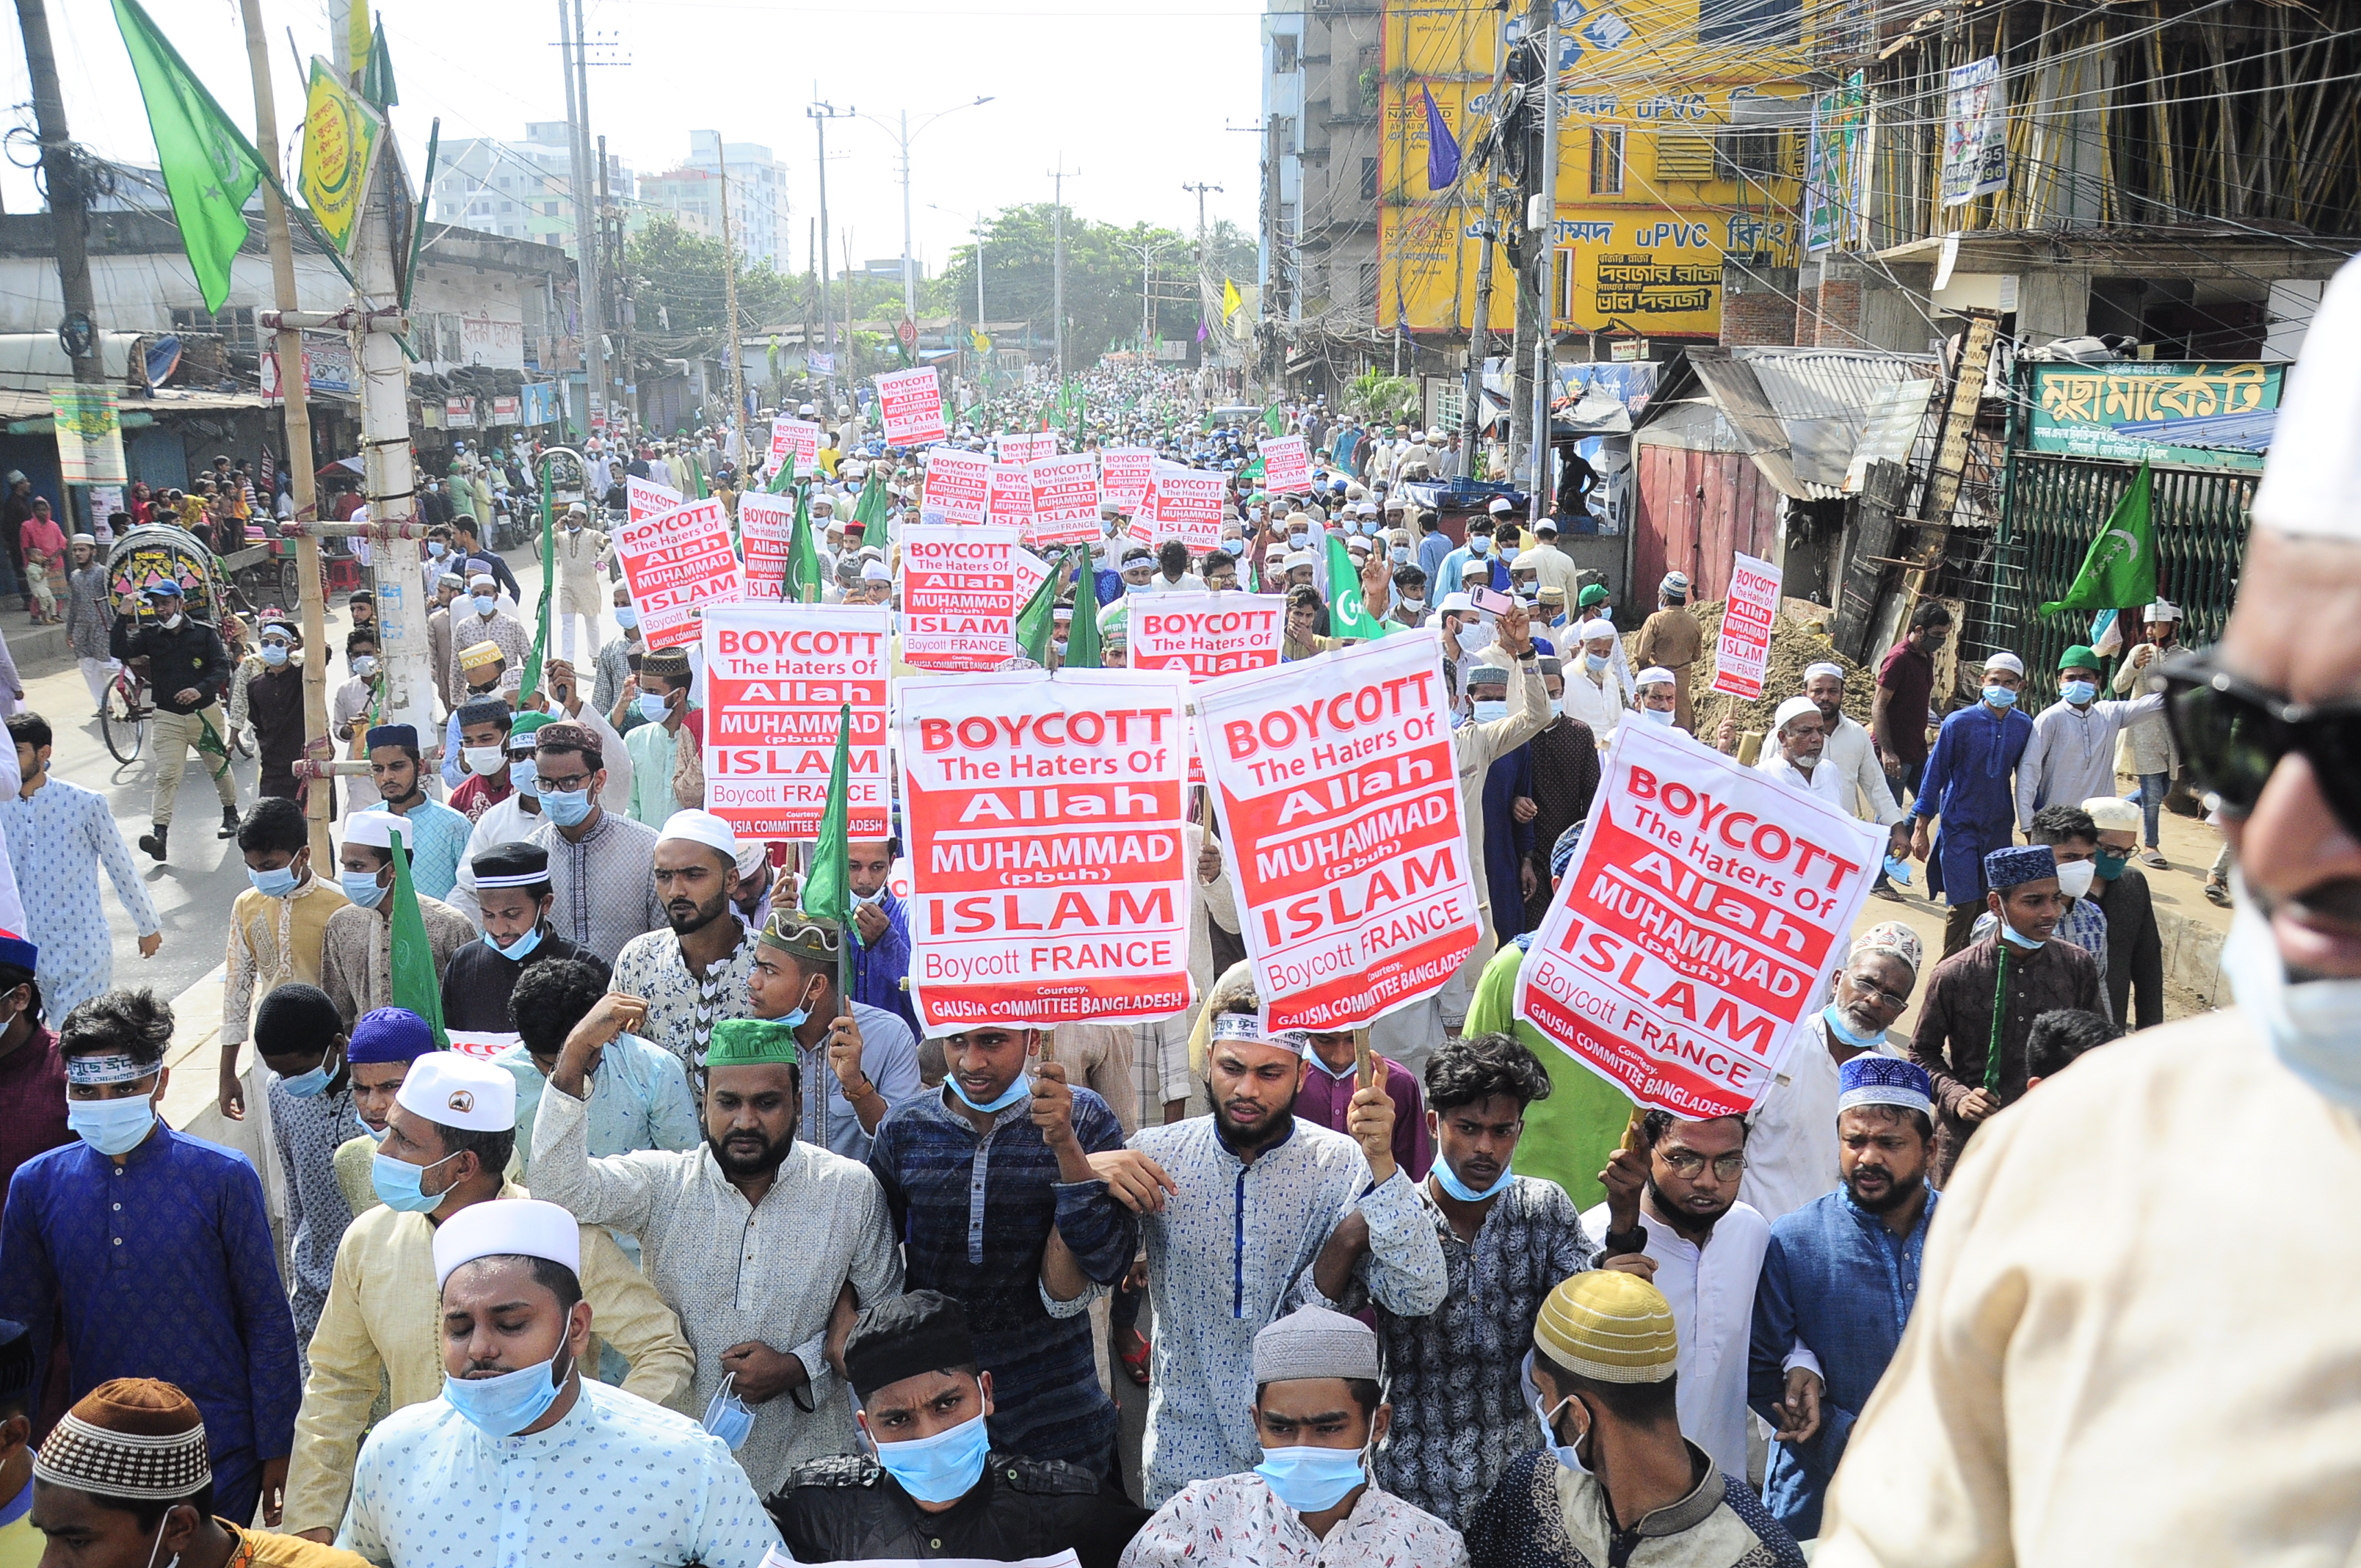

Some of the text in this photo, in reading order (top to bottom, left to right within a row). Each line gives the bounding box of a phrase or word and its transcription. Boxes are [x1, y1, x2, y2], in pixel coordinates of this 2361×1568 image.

[1636, 222, 1709, 248] uPVC
[1599, 265, 1722, 283] দরজার রাজা
[1597, 290, 1705, 310] ভাল দরজা
[882, 374, 934, 391] BOYCOTT
[2041, 363, 2266, 422] মুছা মার্কেট
[892, 391, 934, 404] Allah
[887, 401, 937, 415] MUHAMMAD
[888, 412, 940, 427] ISLAM
[910, 422, 940, 433] FRANCE
[1003, 440, 1052, 452] BOYCOTT
[932, 458, 988, 472] BOYCOTT
[950, 468, 974, 477] Haters
[1034, 463, 1092, 478] BOYCOTT
[929, 484, 983, 498] MUHAMMAD
[937, 476, 982, 487] Allah
[1043, 483, 1090, 496] Allah
[1163, 479, 1222, 490] BOYCOTT
[637, 500, 648, 508] The
[926, 496, 981, 511] ISLAM
[1037, 495, 1095, 509] MUHAMMAD
[1169, 498, 1216, 508] Allah
[623, 504, 717, 545] BOYCOTT
[744, 507, 790, 527] BOYCOTT
[1037, 508, 1095, 523] ISLAM
[1161, 509, 1219, 520] MUHAMMAD
[748, 525, 789, 538] The Haters Of
[1061, 520, 1095, 530] FRANCE
[1159, 523, 1217, 534] ISLAM
[632, 520, 719, 553] The Haters Of
[1182, 535, 1215, 545] FRANCE
[645, 537, 719, 567] Allah
[910, 542, 1012, 559] BOYCOTT
[637, 553, 730, 589] MUHAMMAD
[918, 559, 1009, 571] The Haters Of
[924, 574, 1004, 589] Allah
[1737, 569, 1777, 597] BOYCOTT
[641, 574, 737, 613] ISLAM
[913, 595, 1010, 609] MUHAMMAD
[1736, 587, 1773, 606] The Of
[646, 611, 683, 630] Boycott
[1734, 601, 1768, 623] Allah
[910, 617, 1009, 634] ISLAM
[1144, 610, 1277, 636] BOYCOTT
[719, 630, 882, 656] BOYCOTT
[908, 639, 1007, 652] Boycott FRANCE
[1152, 633, 1272, 651] The Haters Of
[1722, 637, 1762, 663] ISLAM
[728, 658, 877, 675] The Haters Of
[933, 661, 968, 669] COMMITTEE
[1161, 653, 1264, 673] Allah
[739, 682, 871, 702] Allah
[1224, 669, 1435, 762] BOYCOTT
[764, 734, 839, 744] (pbuh)
[920, 708, 1172, 755] BOYCOTT
[1248, 712, 1436, 787] The Haters Of
[718, 749, 880, 774] ISLAM
[938, 748, 1167, 782] The Haters Of
[714, 785, 877, 806] Boycott FRACE
[1277, 755, 1435, 826] Allah
[959, 786, 1158, 823] Allah
[755, 820, 813, 833] COMMITTEE
[1628, 764, 1859, 894] BOYCOTT
[1256, 795, 1448, 884] MUHAMMAD
[932, 834, 1174, 873] MUHAMMAD
[1324, 839, 1401, 881] (pbuh)
[1633, 805, 1837, 919] The Haters Of
[1000, 868, 1111, 886] (pbuh)
[1261, 846, 1457, 948] ISLAM
[1631, 852, 1806, 953] Allah
[929, 888, 1174, 935] ISLAM
[1271, 899, 1464, 993] Boycott FRANCE
[1589, 874, 1799, 998] MUHAMMAD
[926, 940, 1171, 983] Boycott FRANCE
[1637, 931, 1731, 987] (pbuh)
[1367, 961, 1404, 983] Courtesy.
[1037, 986, 1089, 995] Courtesy.
[1559, 918, 1776, 1056] ISLAM
[932, 992, 1182, 1017] GAUSIA COMMITTEE BANGLADESH
[1277, 1003, 1331, 1027] GAUSIA
[1332, 977, 1399, 1015] COMMITTEE
[1536, 962, 1752, 1089] Boycott FRANCE
[1530, 1003, 1573, 1040] GAUSIA
[1577, 1031, 1644, 1086] COMMITTEE
[1617, 1045, 1658, 1075] Courtesy.
